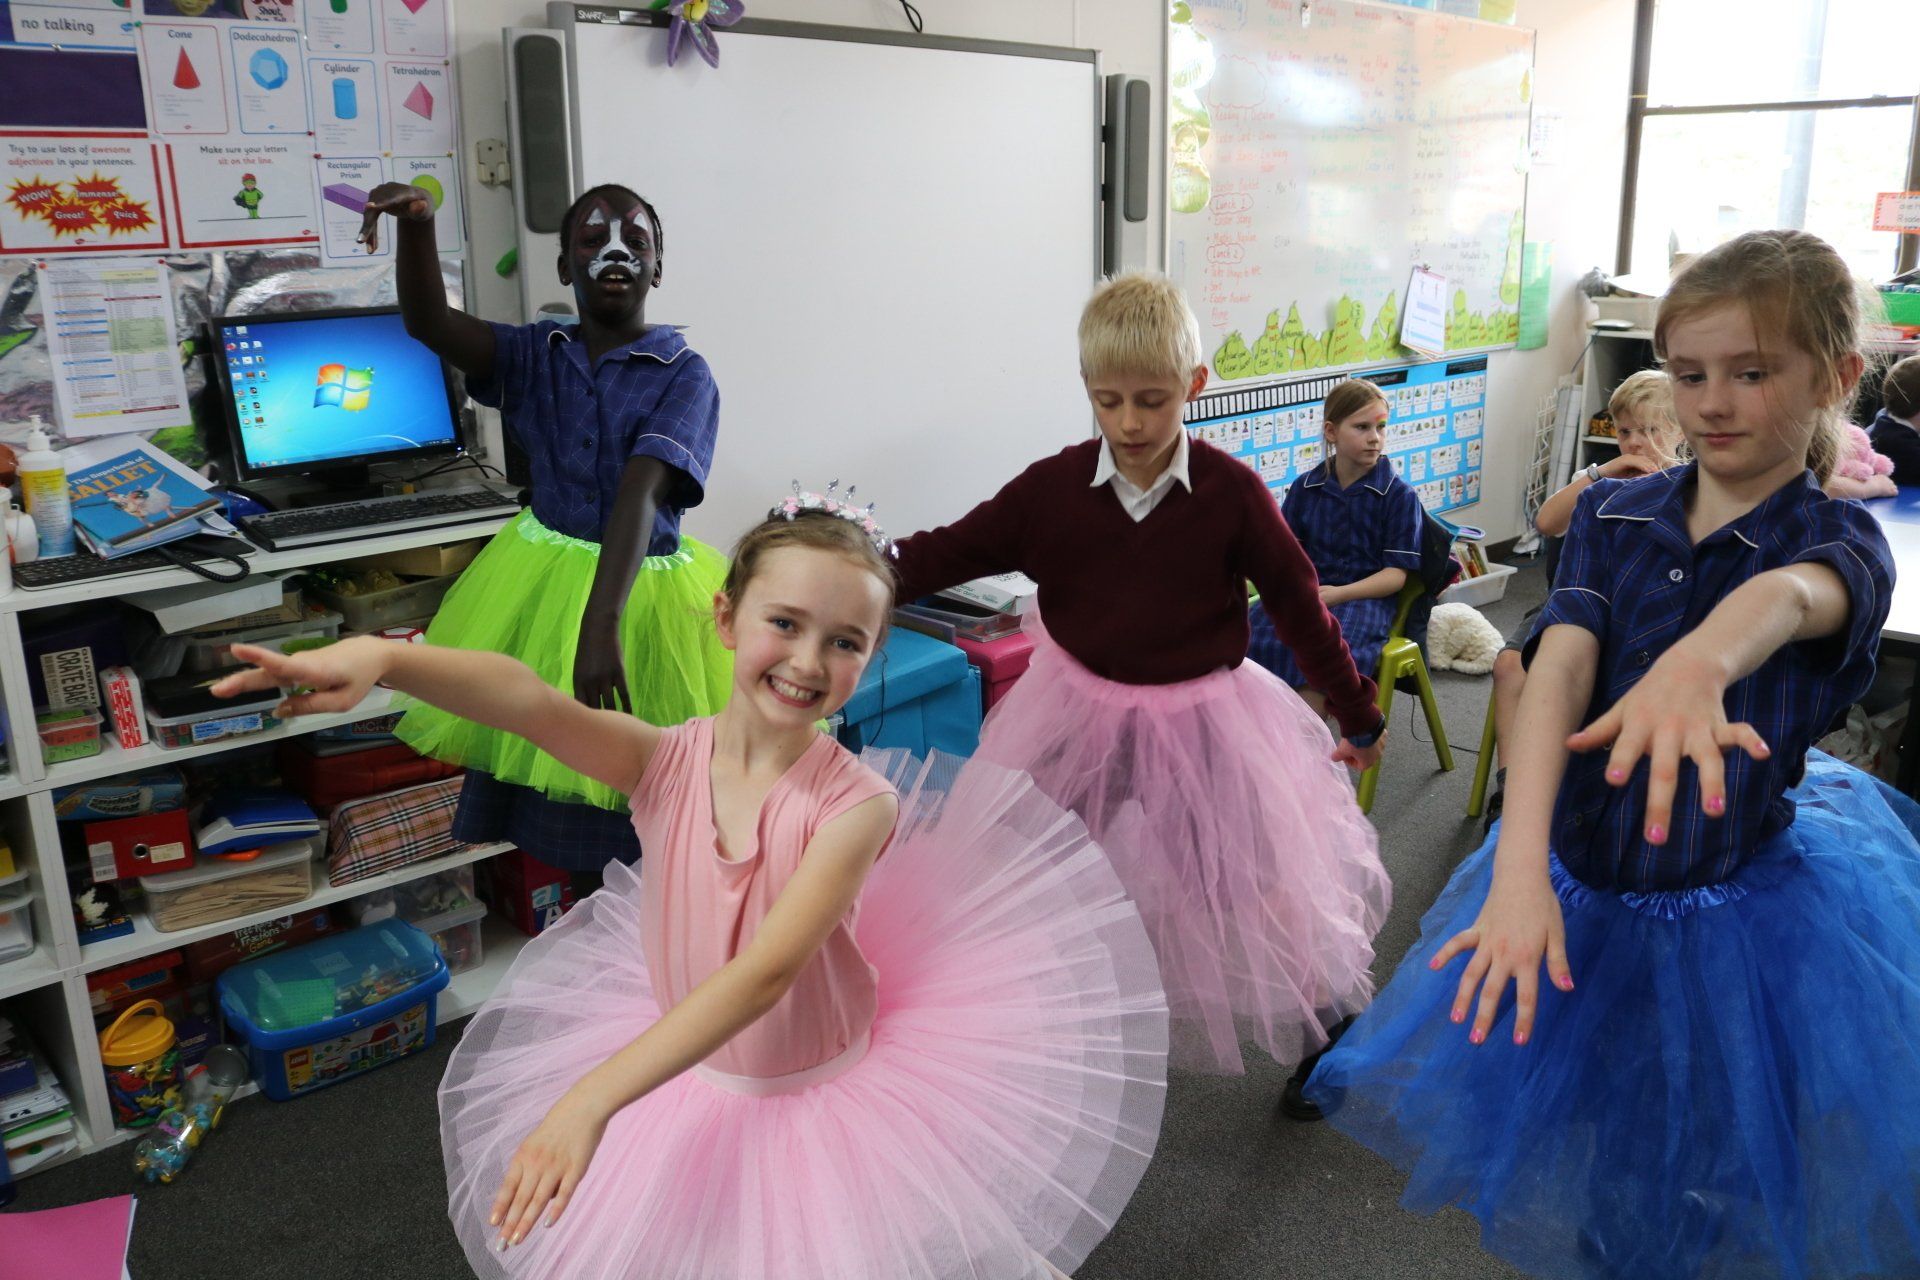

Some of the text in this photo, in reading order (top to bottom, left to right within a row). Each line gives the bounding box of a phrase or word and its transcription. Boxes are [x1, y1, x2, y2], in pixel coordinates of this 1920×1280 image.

[259, 6, 283, 17] Shout,
[577, 9, 602, 20] SMART
[21, 18, 95, 36] no talking
[167, 29, 193, 39] Cone
[232, 31, 297, 43] Dodecahedron
[323, 63, 360, 75] Cylinder
[392, 66, 442, 77] Tetrahedron
[8, 143, 25, 155] Try
[27, 144, 37, 153] to
[59, 144, 77, 153] lots
[79, 144, 89, 155] of
[91, 146, 132, 154] awesome
[199, 145, 223, 155] Make
[244, 147, 262, 156] your
[264, 145, 288, 153] letters
[8, 157, 136, 169] adjectives in your sentences.
[218, 157, 229, 166] sit
[243, 157, 256, 165] the
[258, 156, 274, 165] line.
[327, 161, 372, 170] Rectangular
[409, 160, 437, 171] Sphere
[340, 171, 362, 179] Prism
[18, 188, 53, 204] WOW!
[74, 189, 119, 198] Immense!
[54, 210, 85, 220] Great!
[56, 651, 87, 685] CRATE
[81, 648, 98, 706] QUADRANT
[249, 937, 274, 953] Game
